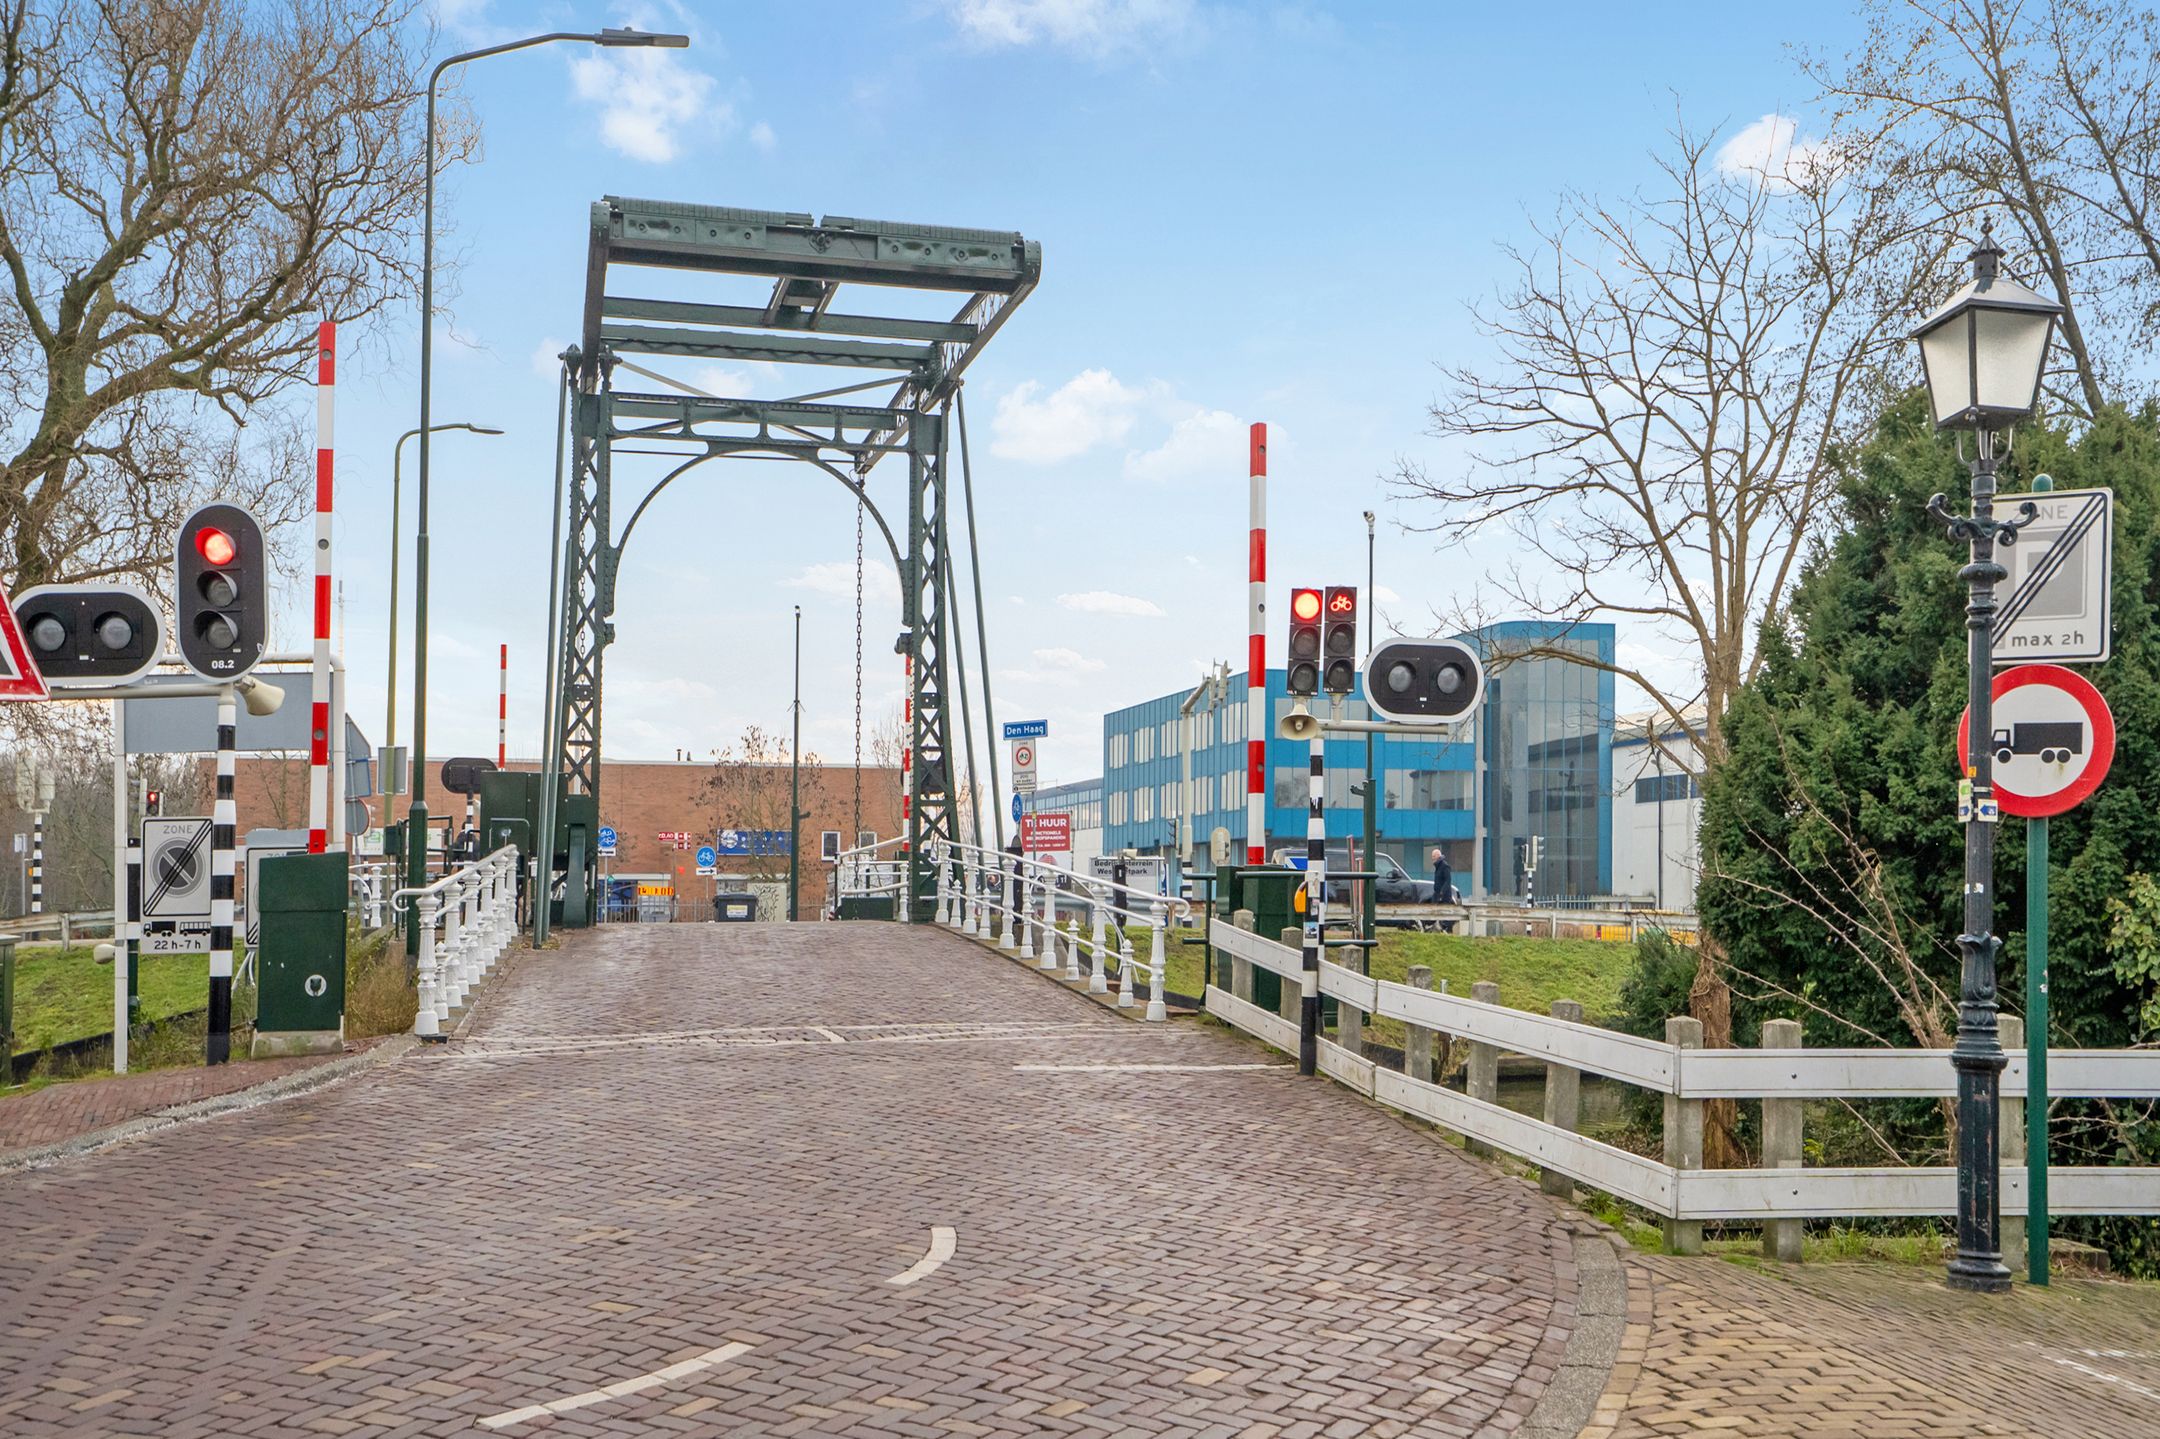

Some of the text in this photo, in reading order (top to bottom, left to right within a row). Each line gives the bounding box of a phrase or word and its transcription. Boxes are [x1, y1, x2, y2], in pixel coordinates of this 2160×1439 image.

[2011, 630, 2084, 647] max 2h
[211, 660, 235, 669] 08.2
[1006, 725, 1044, 735] Den Haag
[1039, 818, 1067, 828] HUUR
[163, 825, 194, 834] ZONE
[154, 940, 169, 950] 22
